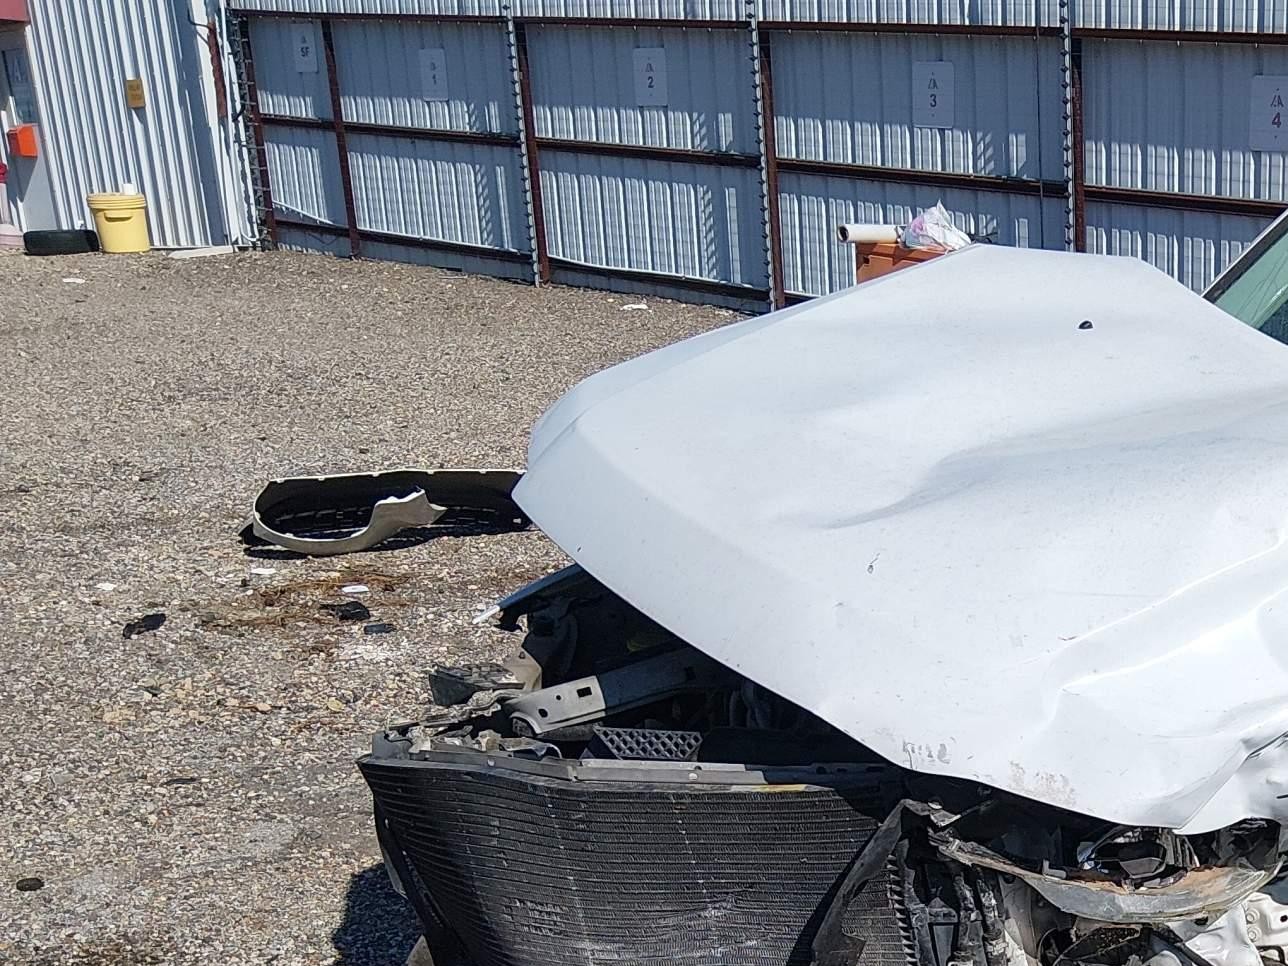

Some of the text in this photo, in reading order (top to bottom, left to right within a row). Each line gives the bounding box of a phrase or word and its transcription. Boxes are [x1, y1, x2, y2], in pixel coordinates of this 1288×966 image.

[646, 76, 655, 89] 2
[929, 94, 938, 108] 3
[1271, 112, 1282, 128] 4
